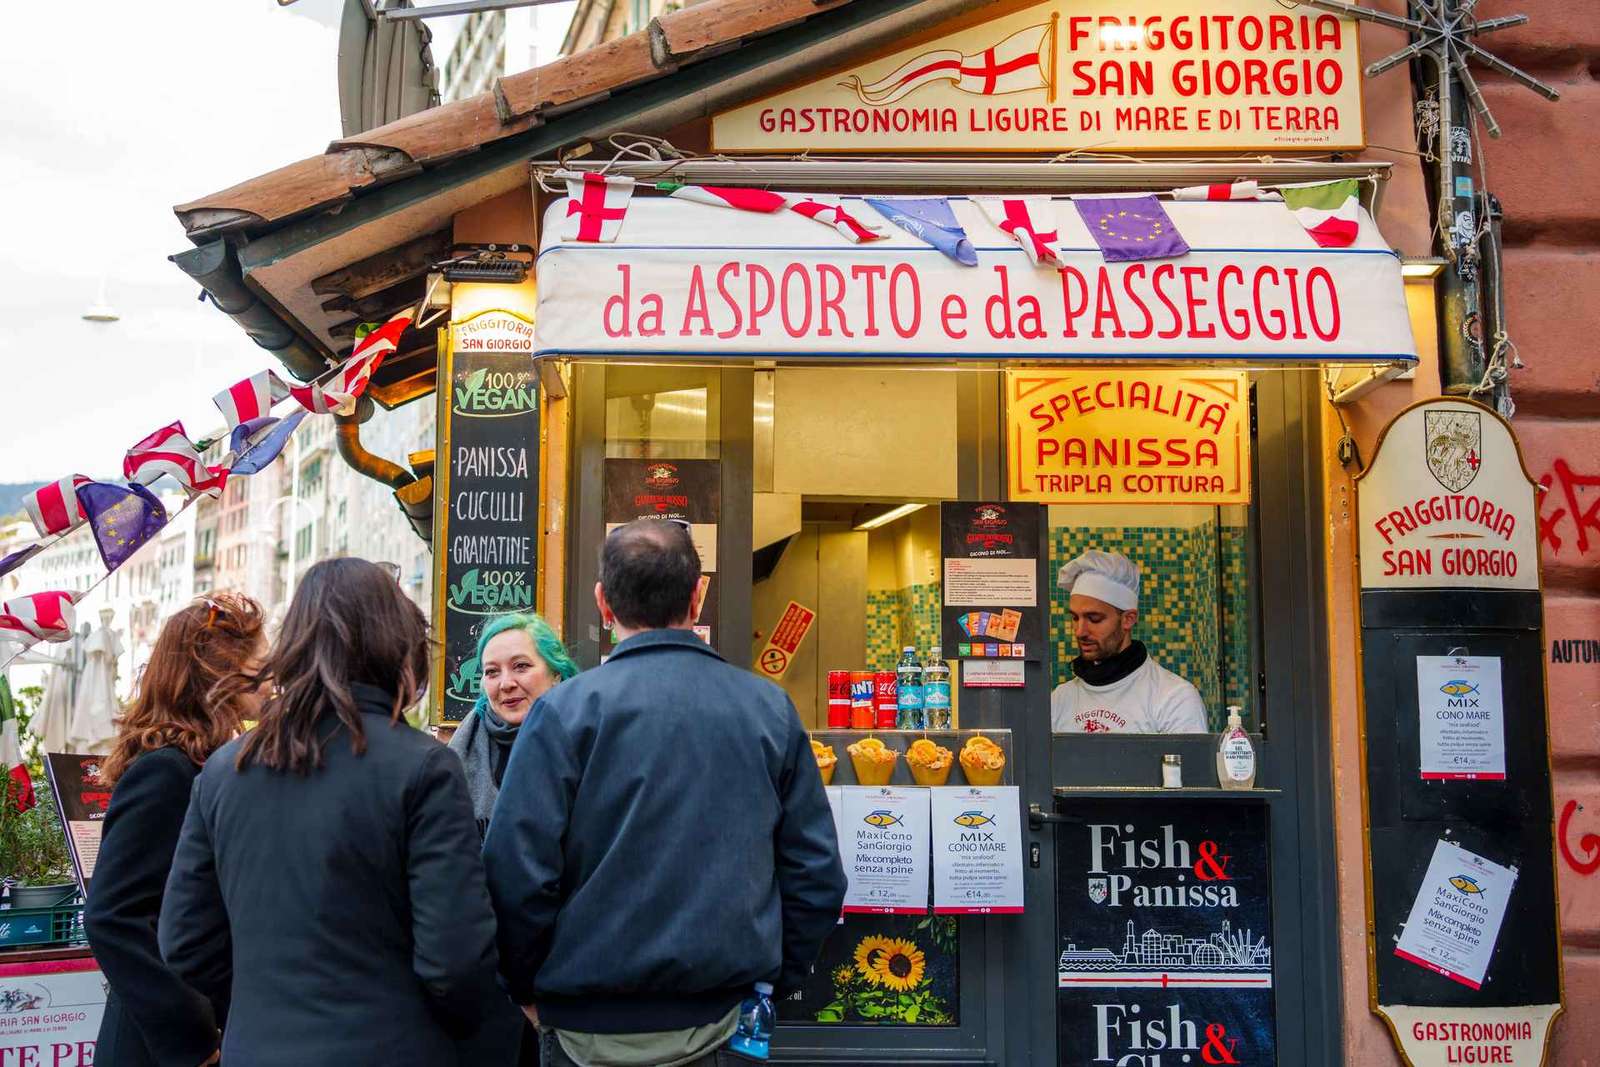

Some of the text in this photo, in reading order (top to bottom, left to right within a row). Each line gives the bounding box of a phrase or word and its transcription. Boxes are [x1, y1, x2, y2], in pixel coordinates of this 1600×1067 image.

[1072, 58, 1343, 97] SAN GIORGIO
[759, 106, 1340, 134] GASTRONOMIA LIGURE DI MARE E DI TERRA
[602, 261, 1341, 343] da ASPORTO e da PASSEGGIO
[461, 319, 534, 338] FRIGGITORIA
[462, 338, 532, 350] SAN GIORGIO
[454, 387, 537, 410] VEGAN
[1029, 379, 1231, 435] SPECIALITÀ
[456, 447, 529, 479] PANISSA
[1036, 437, 1219, 467] PANISSA
[1035, 473, 1225, 493] TRIPLA COTTURA
[456, 490, 524, 522] CUCULLI
[1373, 494, 1517, 545] FRIGGITORIA
[453, 535, 532, 565] GRANATINE
[1381, 548, 1518, 578] SAN GIORGIO
[481, 570, 527, 586] 100%
[449, 583, 533, 606] VEGAN
[1447, 698, 1480, 708] MIX
[1436, 710, 1491, 720] CONO MARE
[856, 830, 913, 841] MaxiCono
[857, 840, 913, 853] SanGiorgio
[947, 842, 1007, 852] CONO MARE
[959, 832, 995, 842] MIX
[854, 864, 914, 875] senza spine
[1107, 873, 1240, 908] Panissa
[1435, 886, 1490, 915] MaxiCono
[1432, 896, 1486, 925] SanGiorgio
[1423, 916, 1453, 936] senza
[1452, 928, 1481, 947] spine
[21, 1015, 40, 1026] SAN
[43, 1012, 87, 1024] GIORGIO
[1412, 1021, 1532, 1042] GASTRONOMIA
[1447, 1045, 1514, 1063] LIGURE
